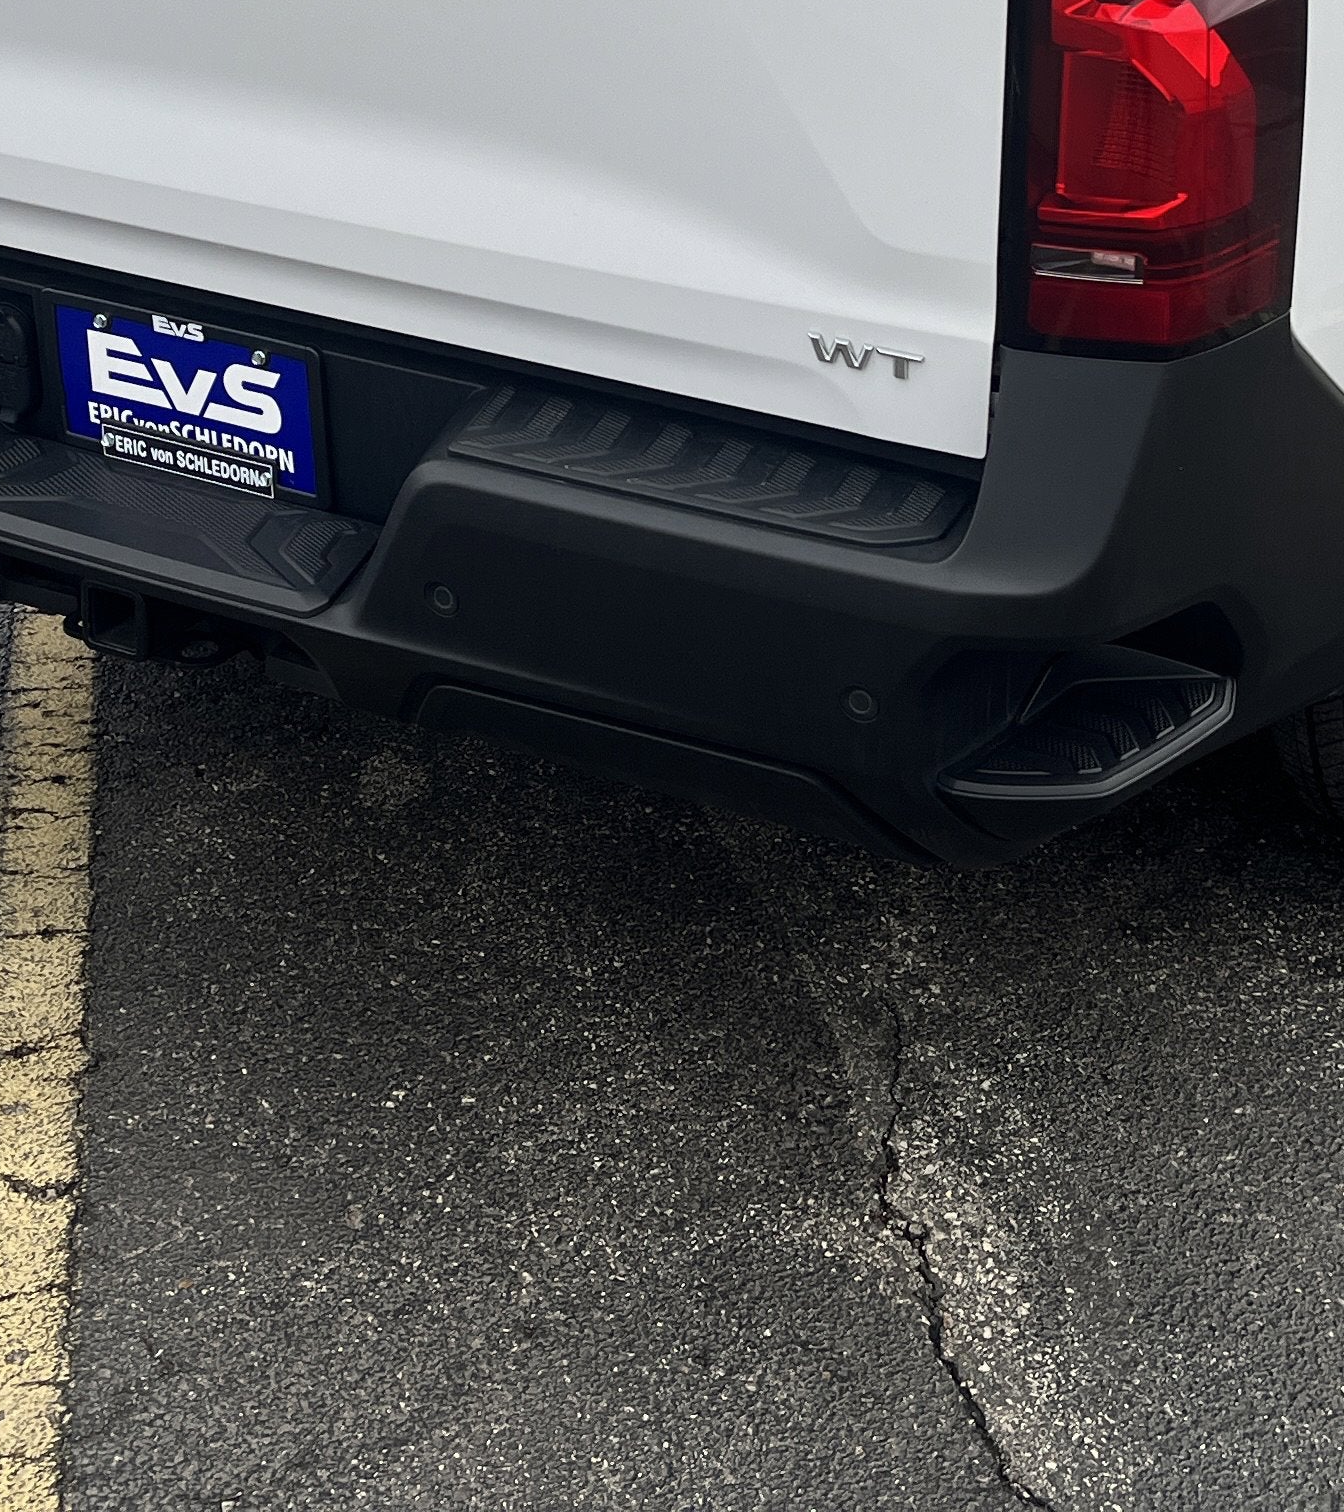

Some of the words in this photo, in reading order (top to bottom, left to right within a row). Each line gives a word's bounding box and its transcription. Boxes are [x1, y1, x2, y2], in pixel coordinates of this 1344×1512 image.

[807, 332, 926, 380] WT
[115, 434, 148, 458] ERIC
[150, 446, 174, 465] von
[176, 450, 261, 487] SCHLEDORN
